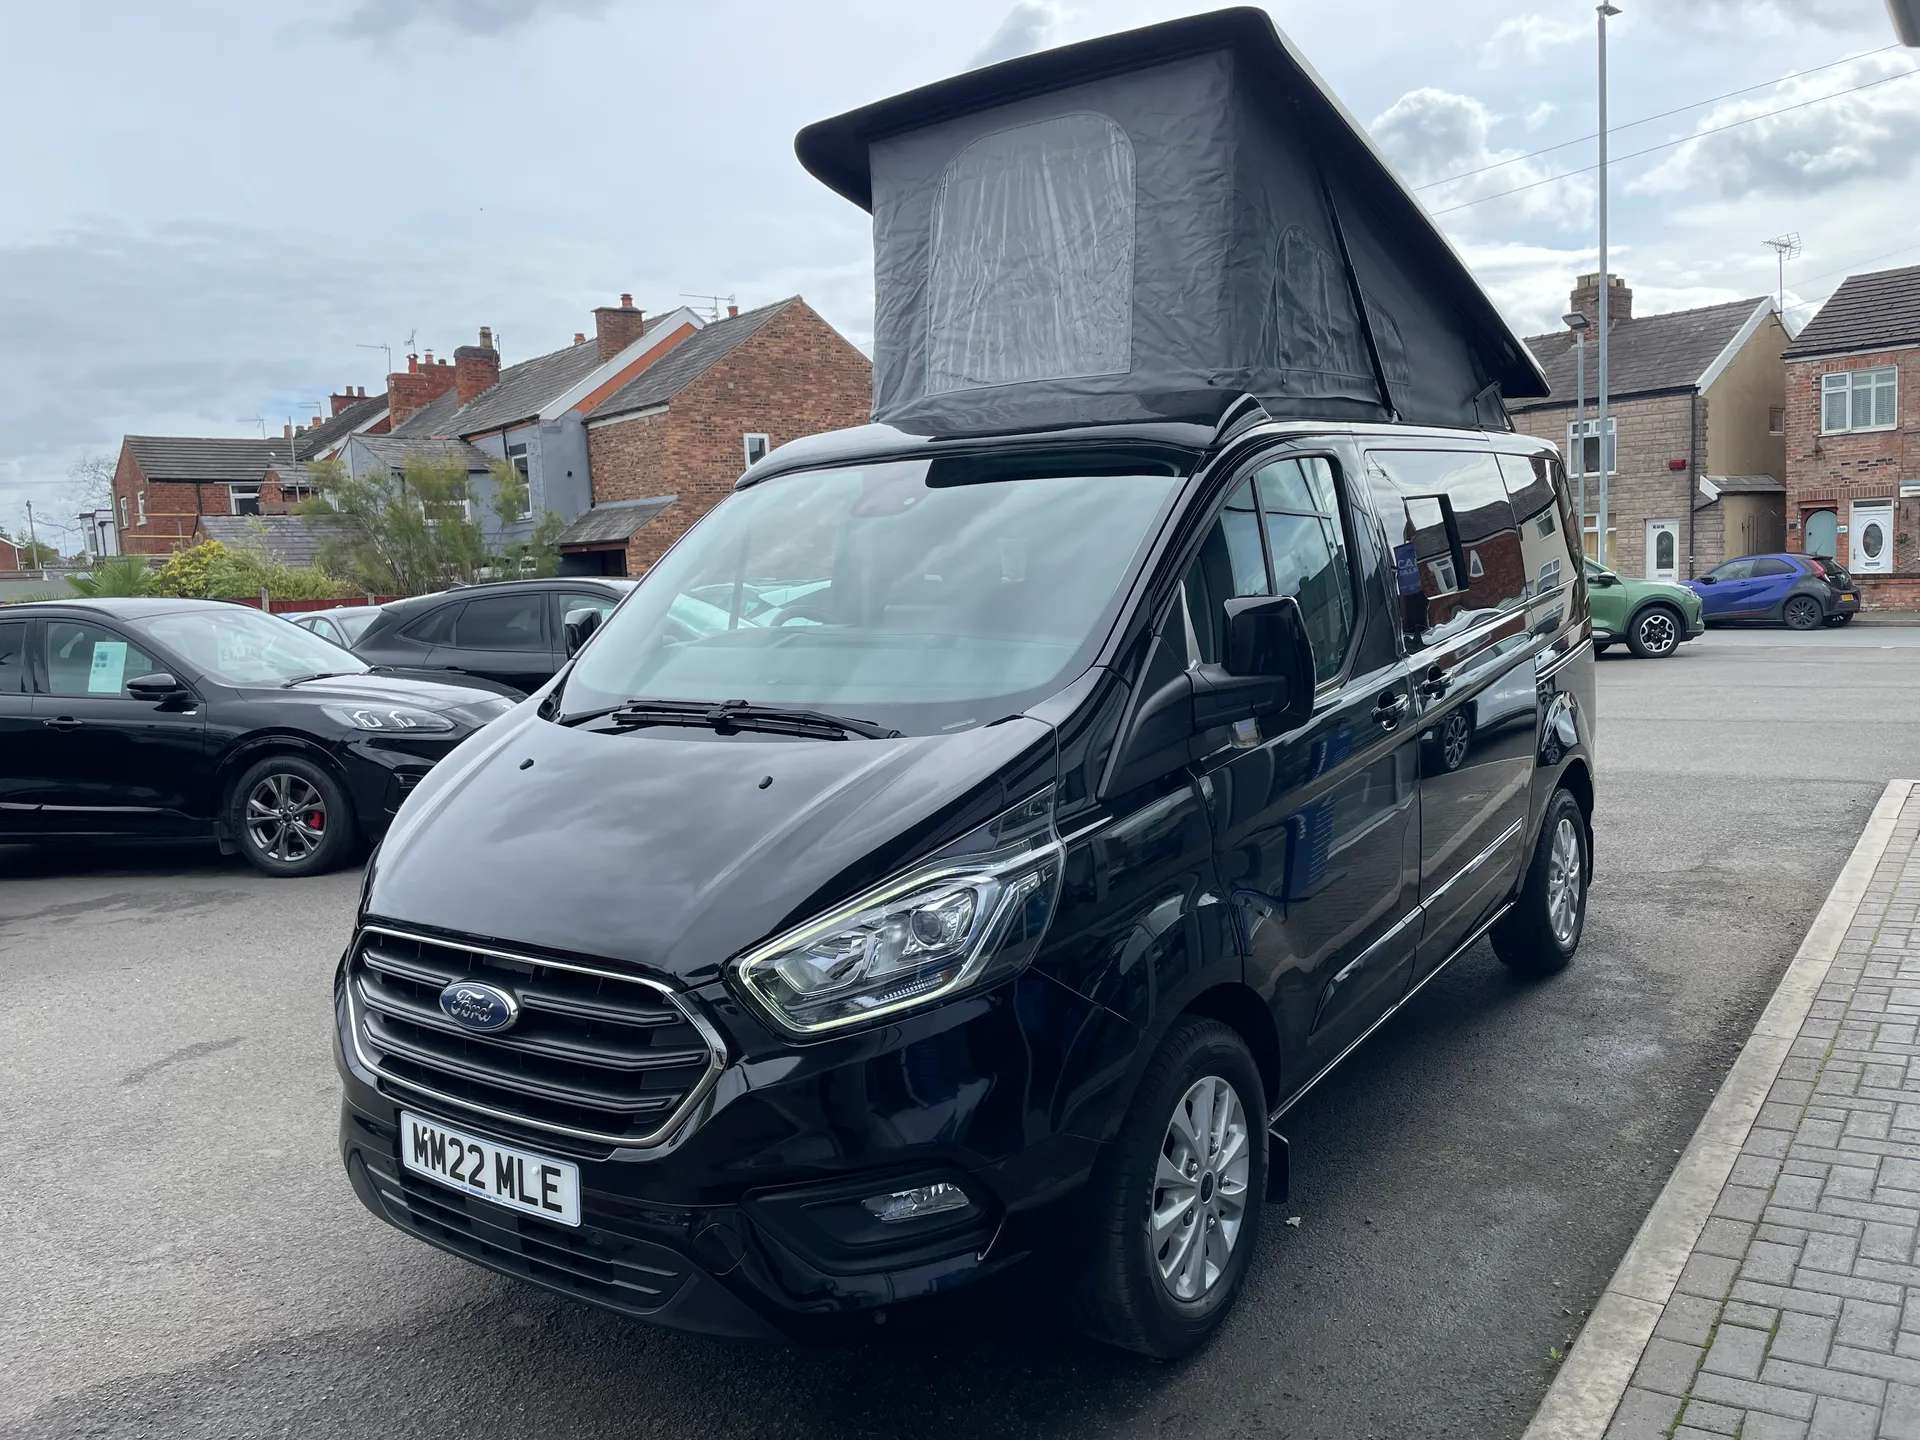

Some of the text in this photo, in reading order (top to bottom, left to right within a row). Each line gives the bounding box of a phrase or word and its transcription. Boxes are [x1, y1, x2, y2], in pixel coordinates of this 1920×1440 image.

[450, 989, 494, 1022] Ford
[412, 1122, 563, 1214] MM22 MLE
